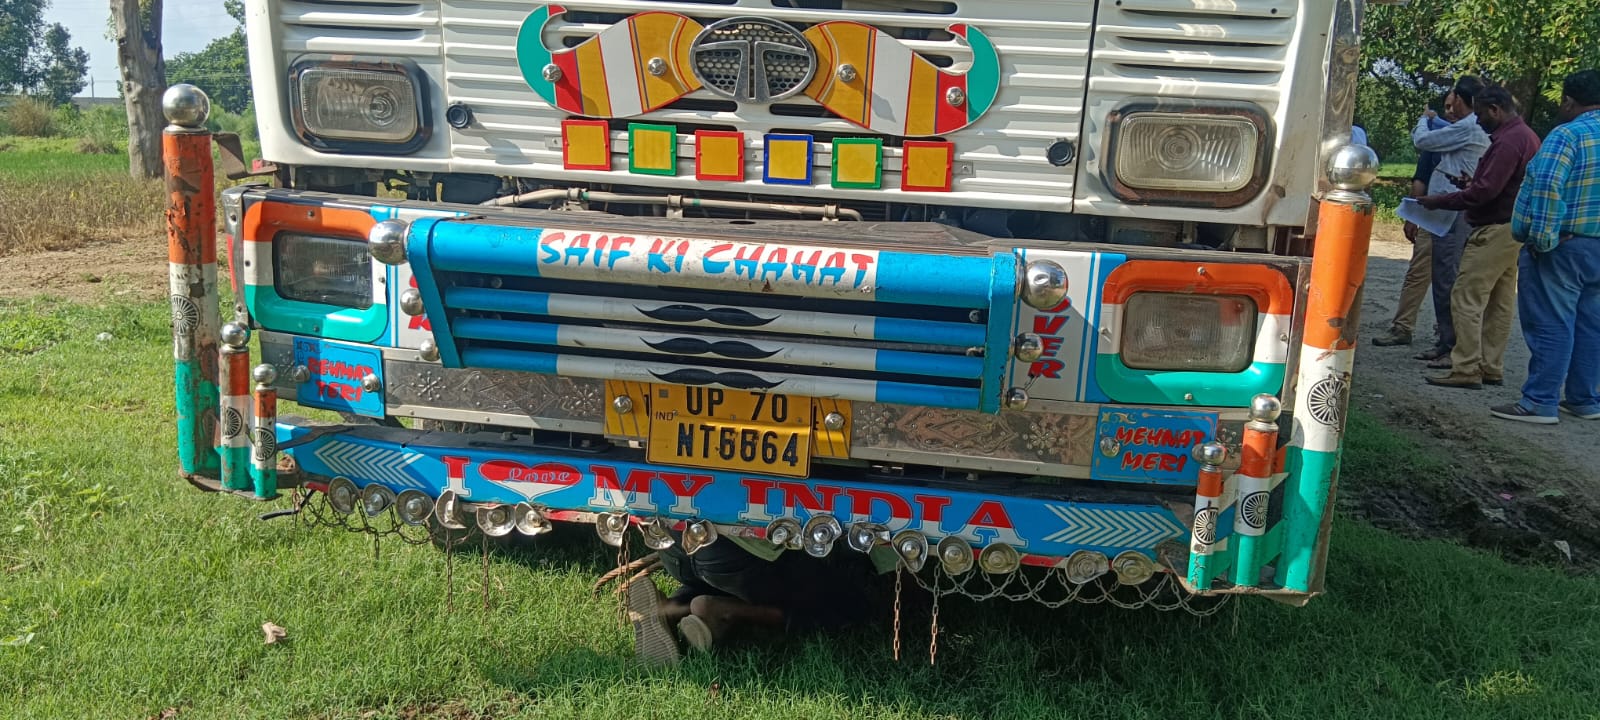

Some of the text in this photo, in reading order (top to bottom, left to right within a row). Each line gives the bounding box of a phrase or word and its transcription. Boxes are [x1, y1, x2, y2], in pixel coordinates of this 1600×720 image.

[540, 231, 874, 290] SAIF KI CHAHAT
[1027, 297, 1072, 379] VER
[655, 411, 674, 421] IND
[686, 385, 724, 417] UP
[750, 391, 788, 423] 70
[1115, 426, 1206, 449] MEHNAT
[1121, 451, 1188, 473] MERI
[440, 456, 471, 497] I
[588, 465, 714, 515] MY
[738, 477, 1029, 548] INDIA
